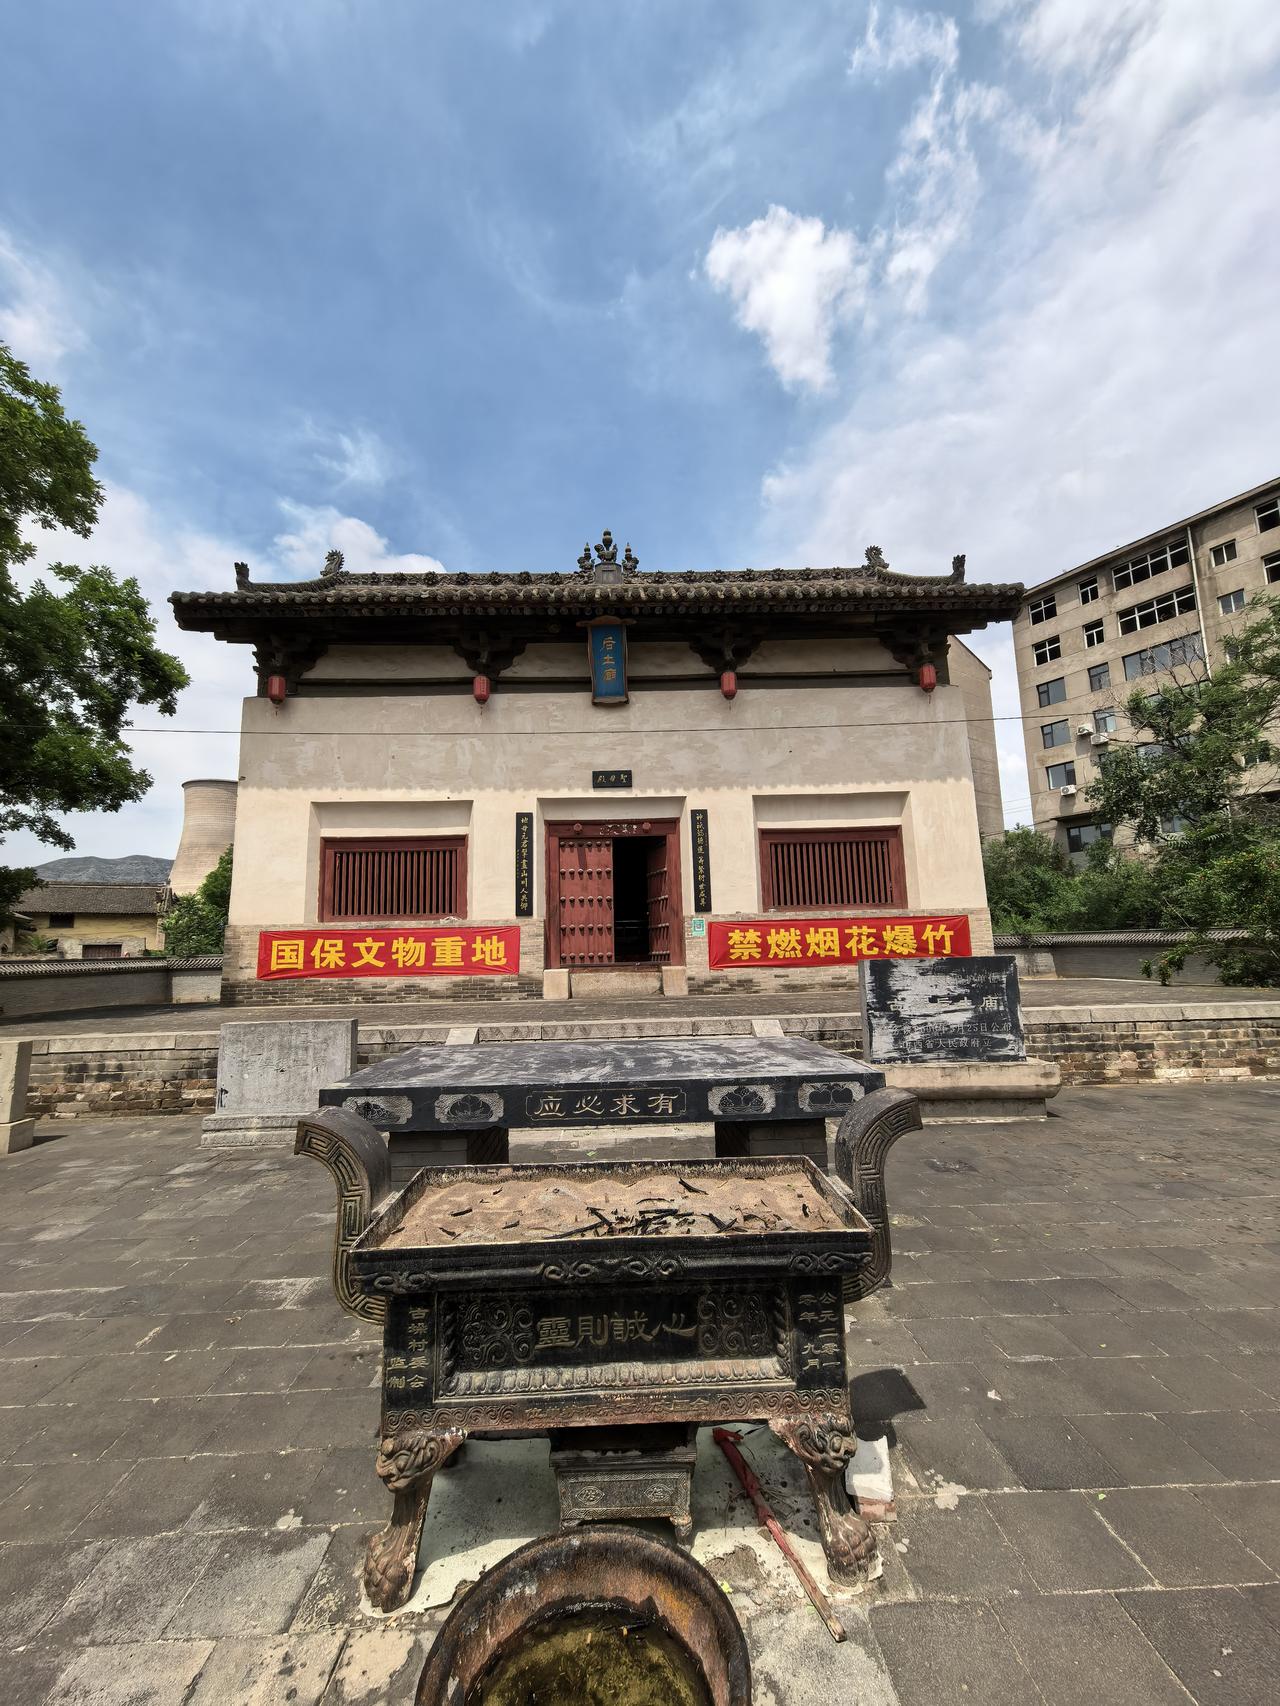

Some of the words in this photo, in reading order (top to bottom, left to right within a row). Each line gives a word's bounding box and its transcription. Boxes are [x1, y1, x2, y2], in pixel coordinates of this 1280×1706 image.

[271, 935, 507, 971] 国保文物重地
[728, 924, 954, 960] 禁燃烟花爆竹
[887, 995, 999, 1011] 古后土庙
[534, 1093, 679, 1117] 有求必应
[534, 1310, 698, 1351] 心誠則靈
